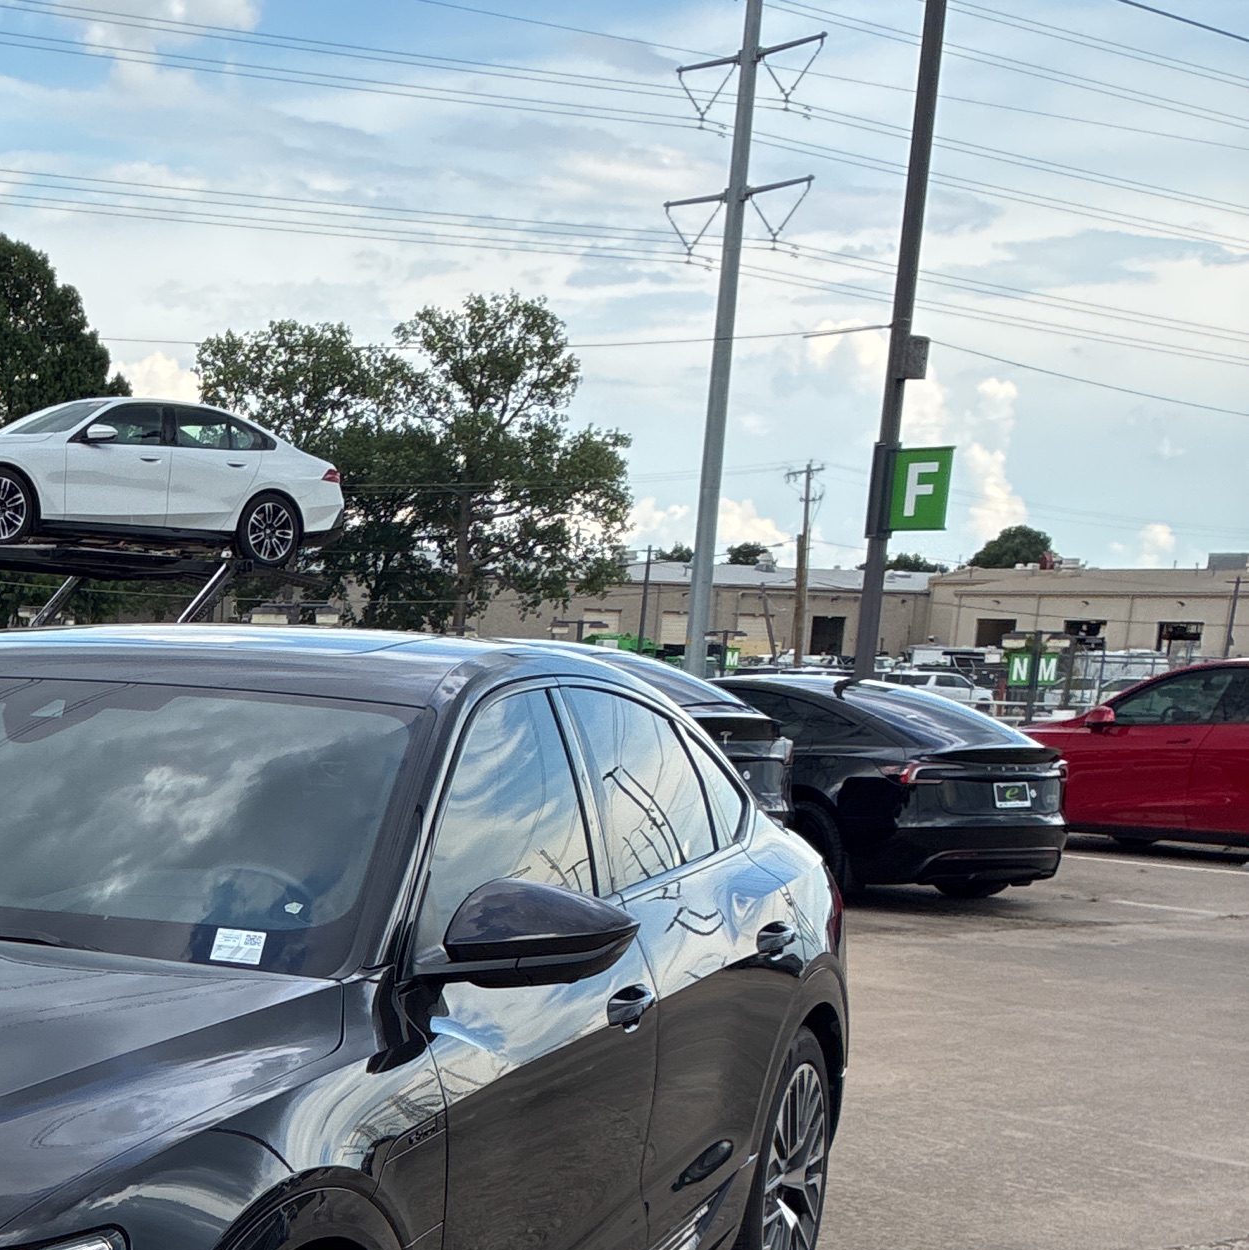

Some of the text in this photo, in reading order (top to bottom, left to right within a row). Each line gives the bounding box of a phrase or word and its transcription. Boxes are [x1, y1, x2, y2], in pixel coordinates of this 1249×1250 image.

[903, 462, 939, 517] F
[726, 651, 739, 666] M
[1012, 657, 1028, 681] N
[1038, 657, 1057, 681] M
